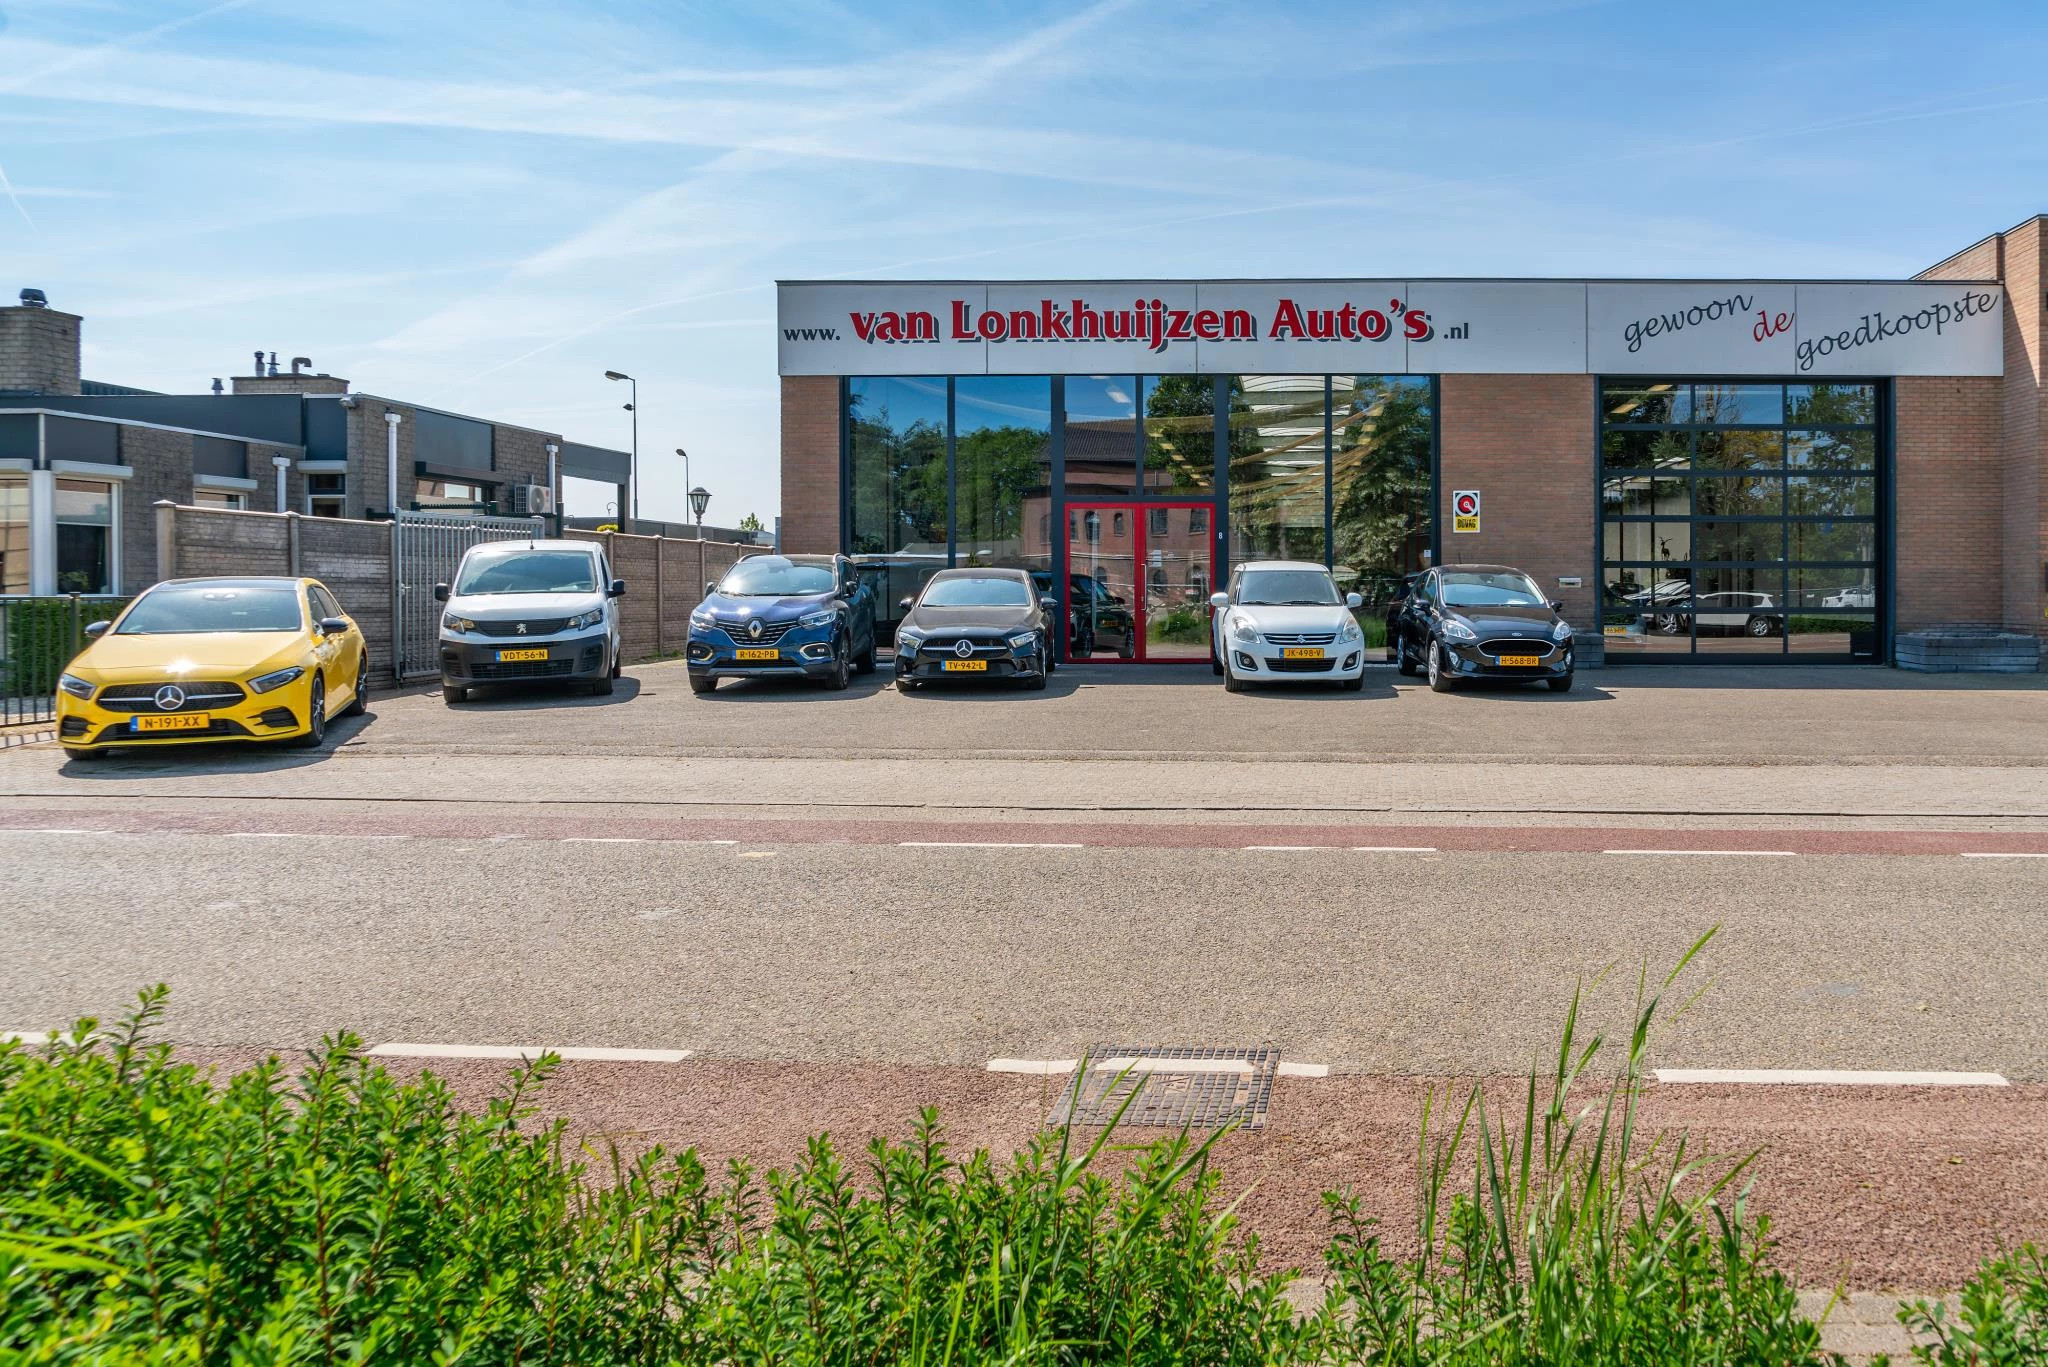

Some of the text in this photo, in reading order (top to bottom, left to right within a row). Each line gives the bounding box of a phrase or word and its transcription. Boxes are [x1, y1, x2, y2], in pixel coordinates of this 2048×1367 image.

[782, 298, 1469, 354] www. van Lonkhuijzen Auto's .nl
[1624, 290, 1998, 371] gewoon de goedkoopste
[1218, 531, 1224, 540] 8
[503, 650, 545, 660] VDT-56-N
[739, 650, 775, 659] R-162-PB
[1286, 649, 1321, 657] JK-498-V
[1501, 656, 1537, 665] H-568-BR
[948, 661, 984, 670] TV-942-L
[144, 716, 200, 728] N-191-XX
